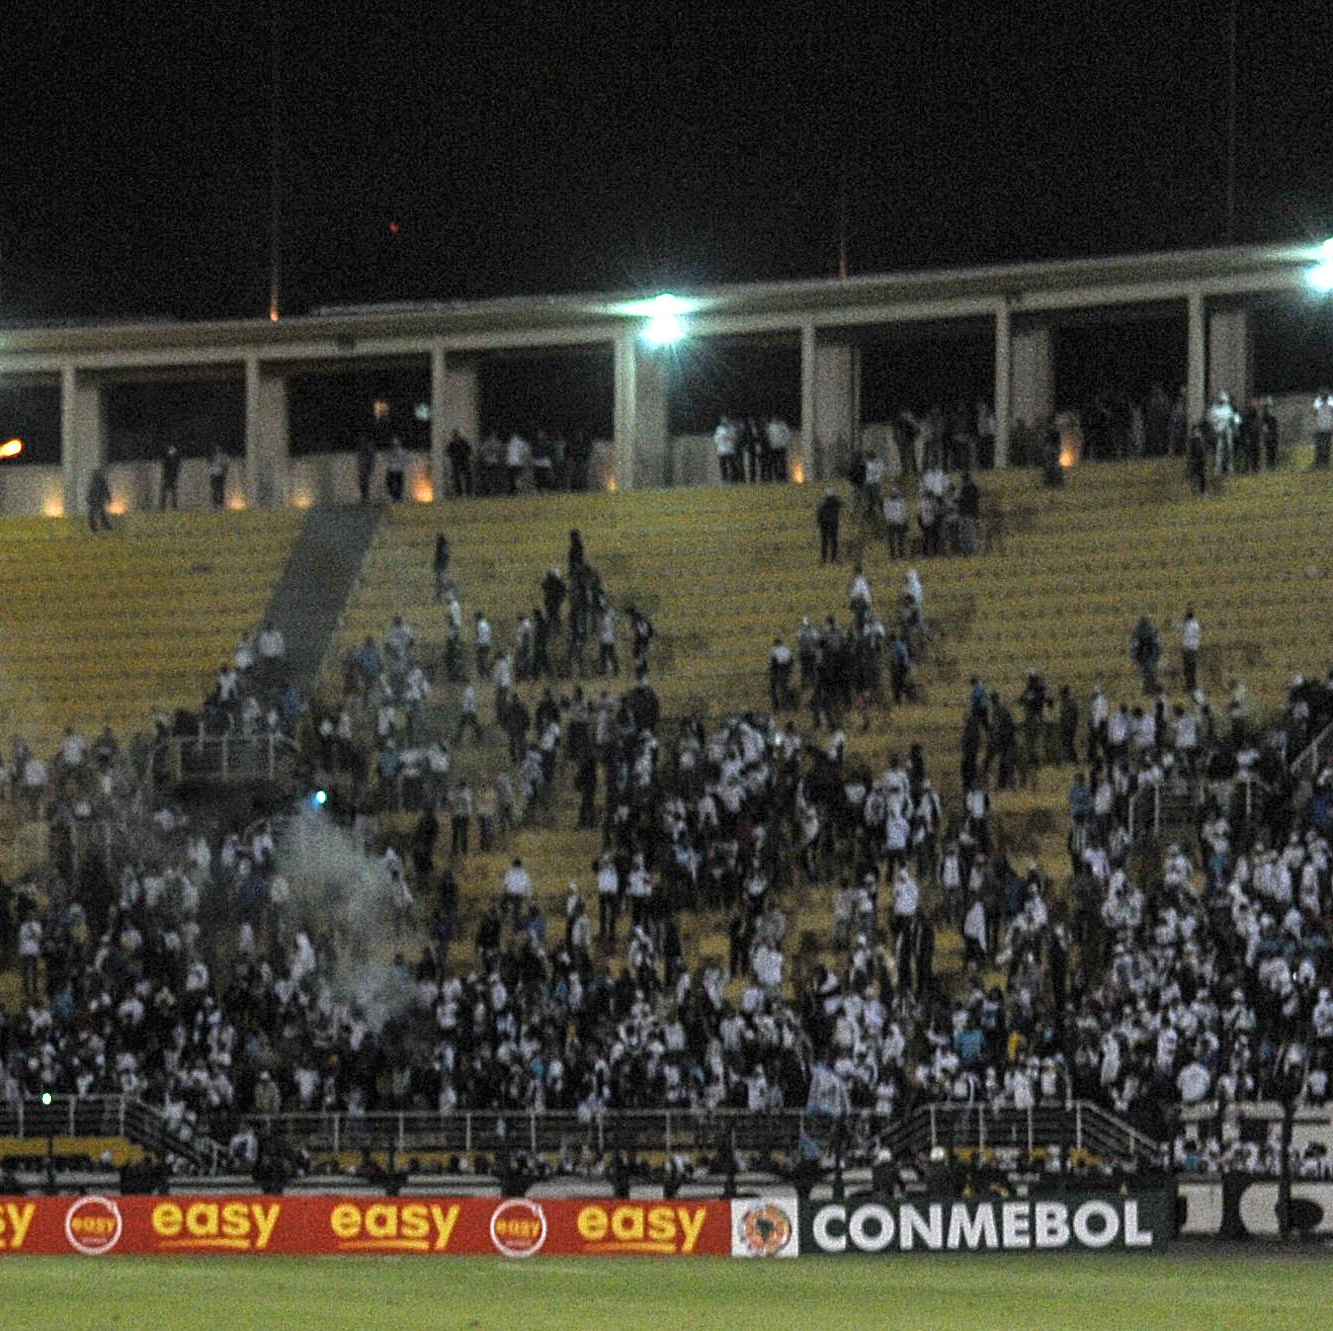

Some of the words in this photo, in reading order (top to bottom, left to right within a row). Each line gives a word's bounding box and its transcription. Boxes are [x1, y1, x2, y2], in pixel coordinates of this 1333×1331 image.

[151, 1201, 280, 1249] easy
[331, 1202, 461, 1250] easy
[577, 1205, 707, 1253] easy
[813, 1200, 1153, 1251] CONMEBOL
